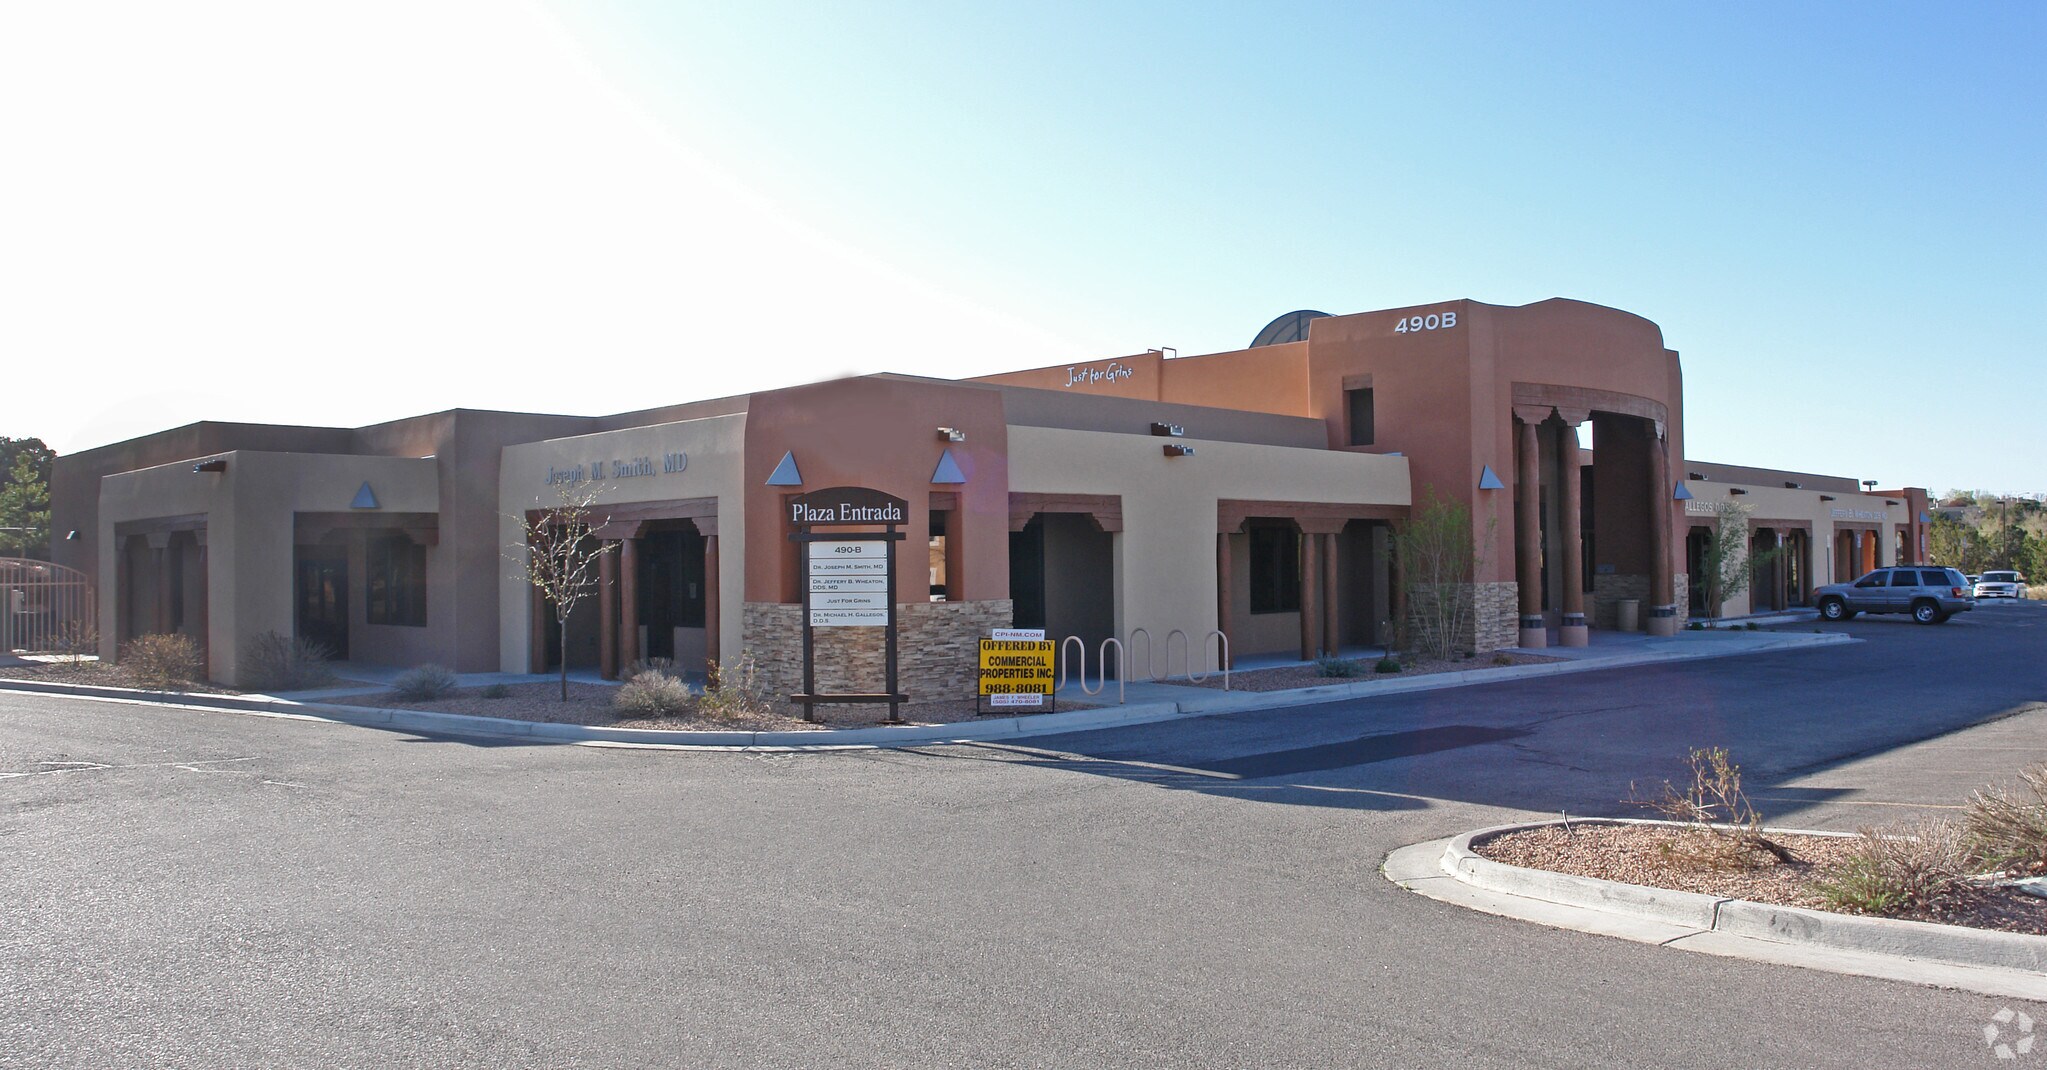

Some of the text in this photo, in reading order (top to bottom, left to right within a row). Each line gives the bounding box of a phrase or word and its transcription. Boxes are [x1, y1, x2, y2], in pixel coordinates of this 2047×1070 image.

[1394, 311, 1457, 334] 490B
[1065, 362, 1132, 387] Just for Grins
[545, 451, 688, 488] Joseph M. Smith, MD
[792, 502, 902, 521] Plaza Entrada
[982, 641, 1053, 651] OFFERED BY
[988, 656, 1046, 666] COMMERCIAL
[980, 668, 1054, 679] PROPERTIES INC.
